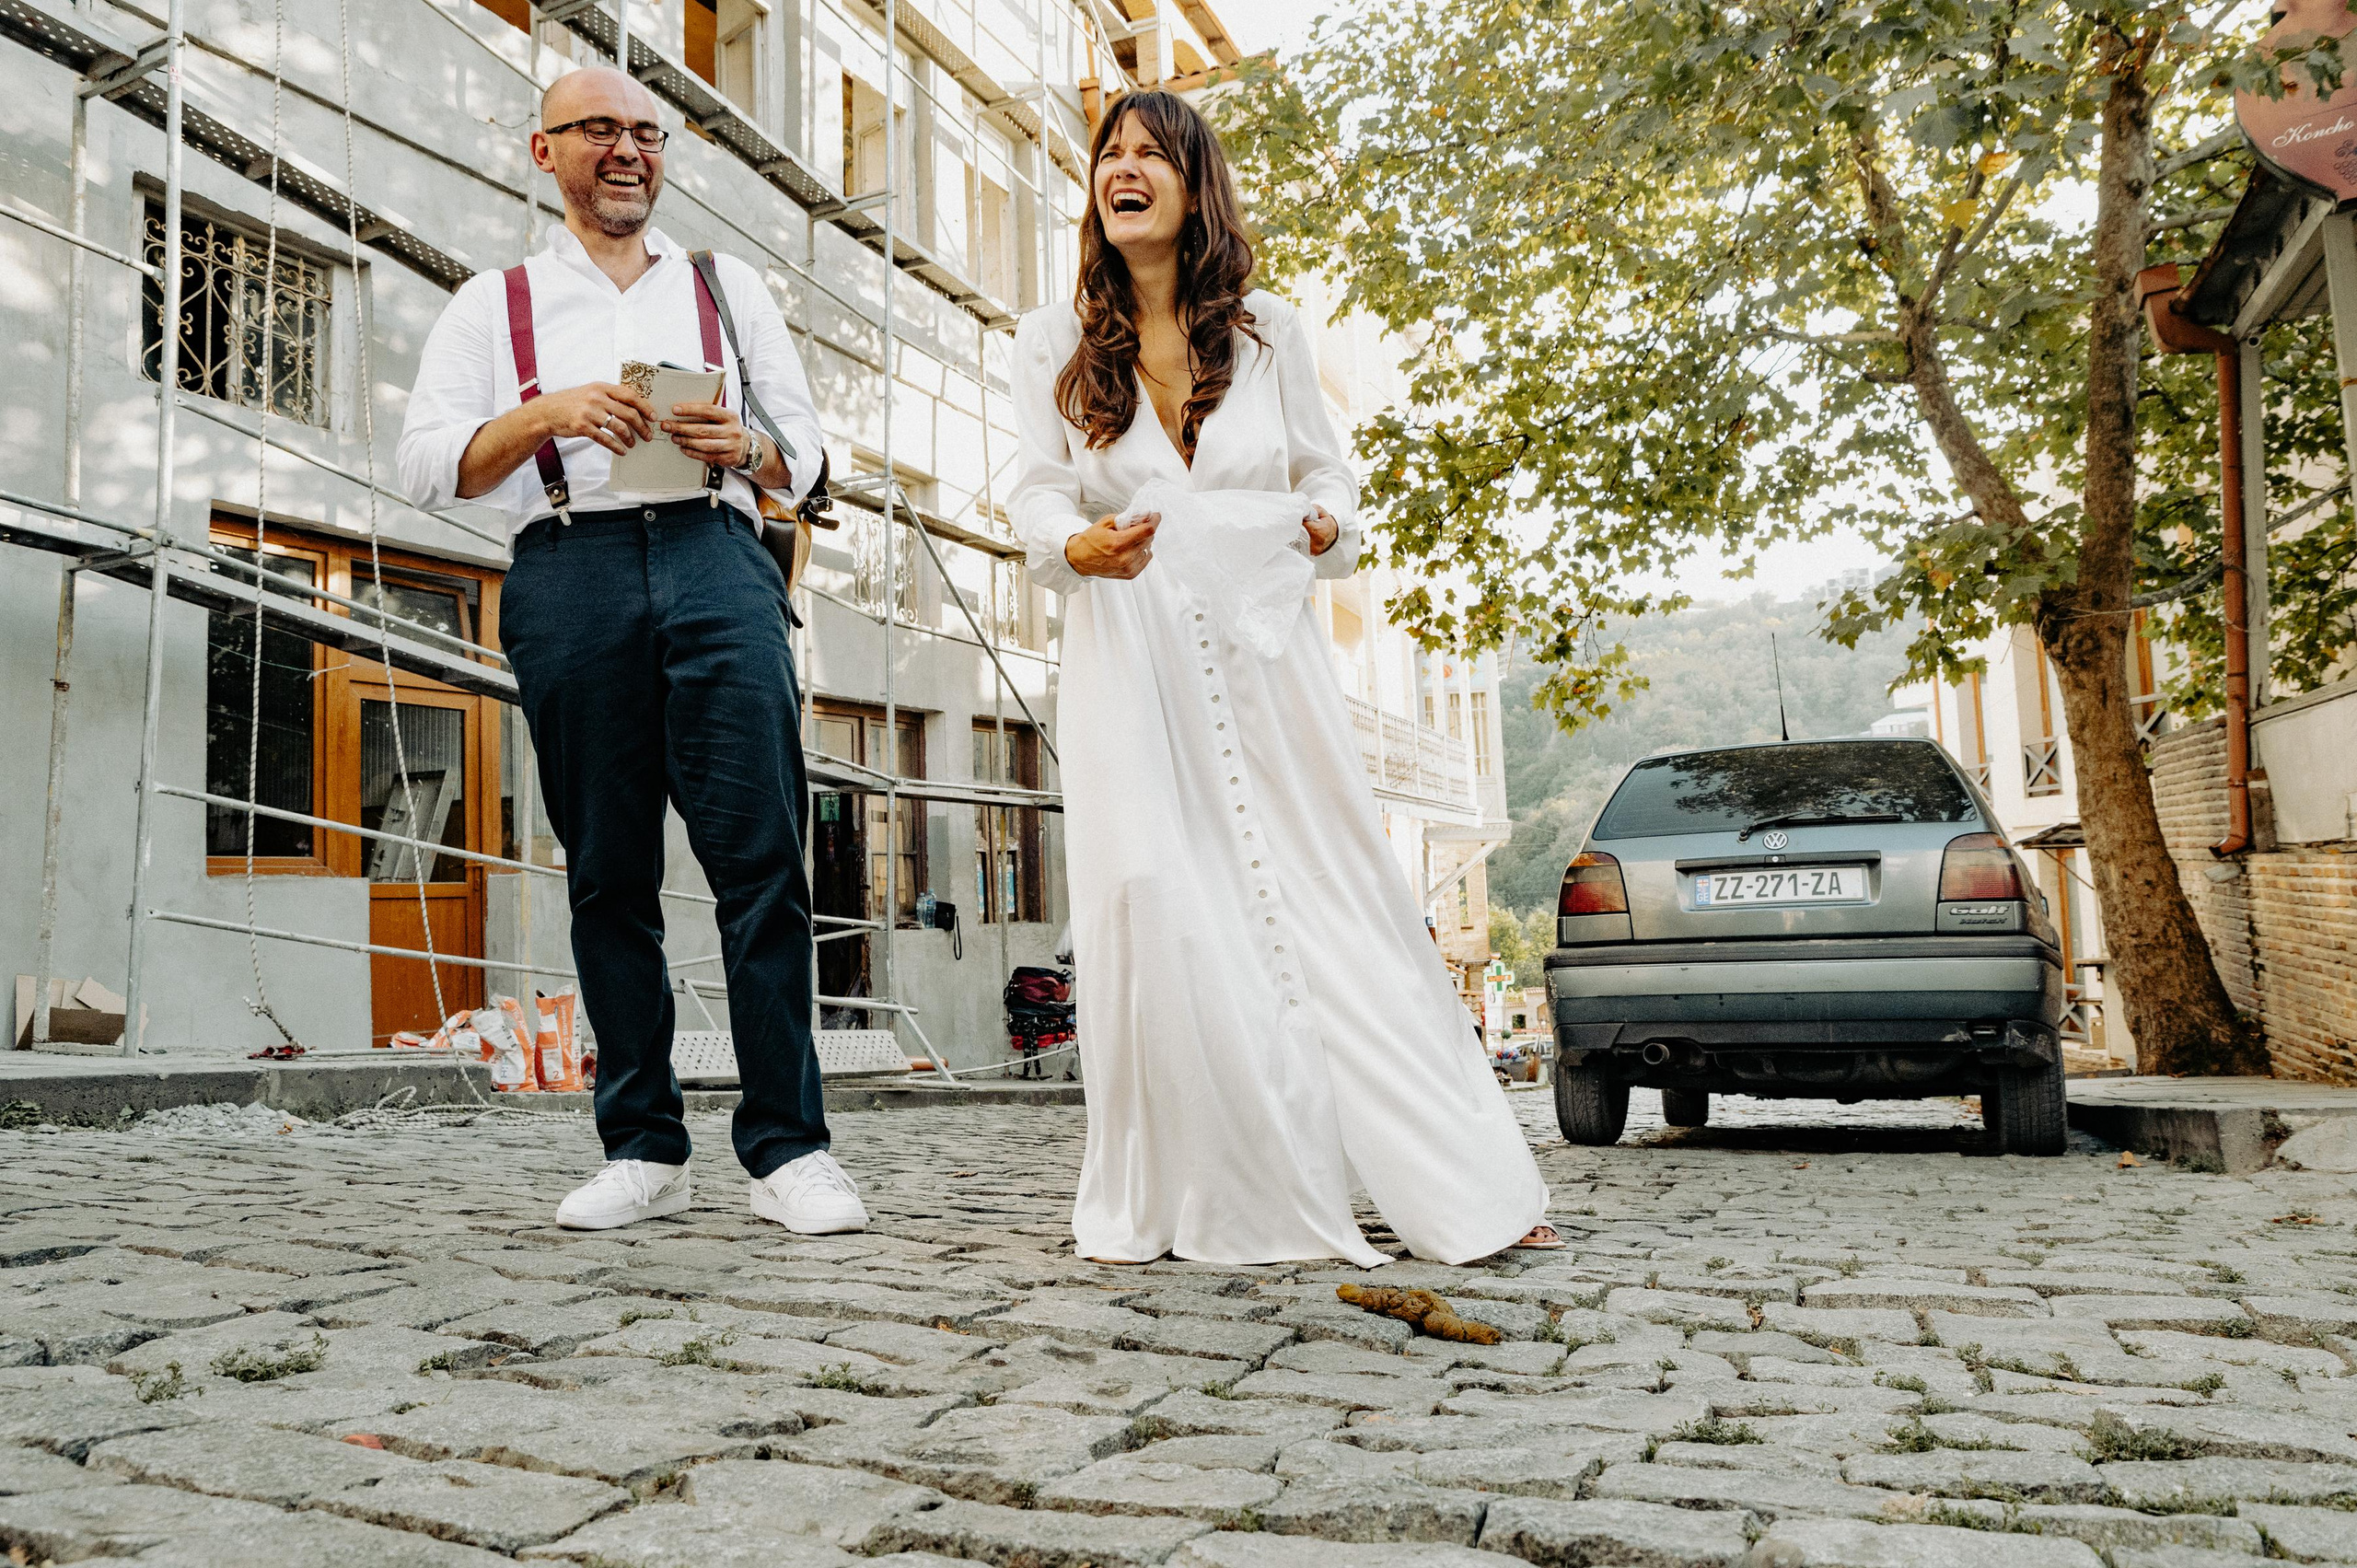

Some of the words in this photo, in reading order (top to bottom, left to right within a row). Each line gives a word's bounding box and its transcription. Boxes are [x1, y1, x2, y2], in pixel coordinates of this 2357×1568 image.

[2271, 115, 2355, 147] Koncho
[1714, 872, 1842, 900] ZZ-271-ZA
[1697, 892, 1709, 902] GE
[1949, 905, 2009, 915] Golf
